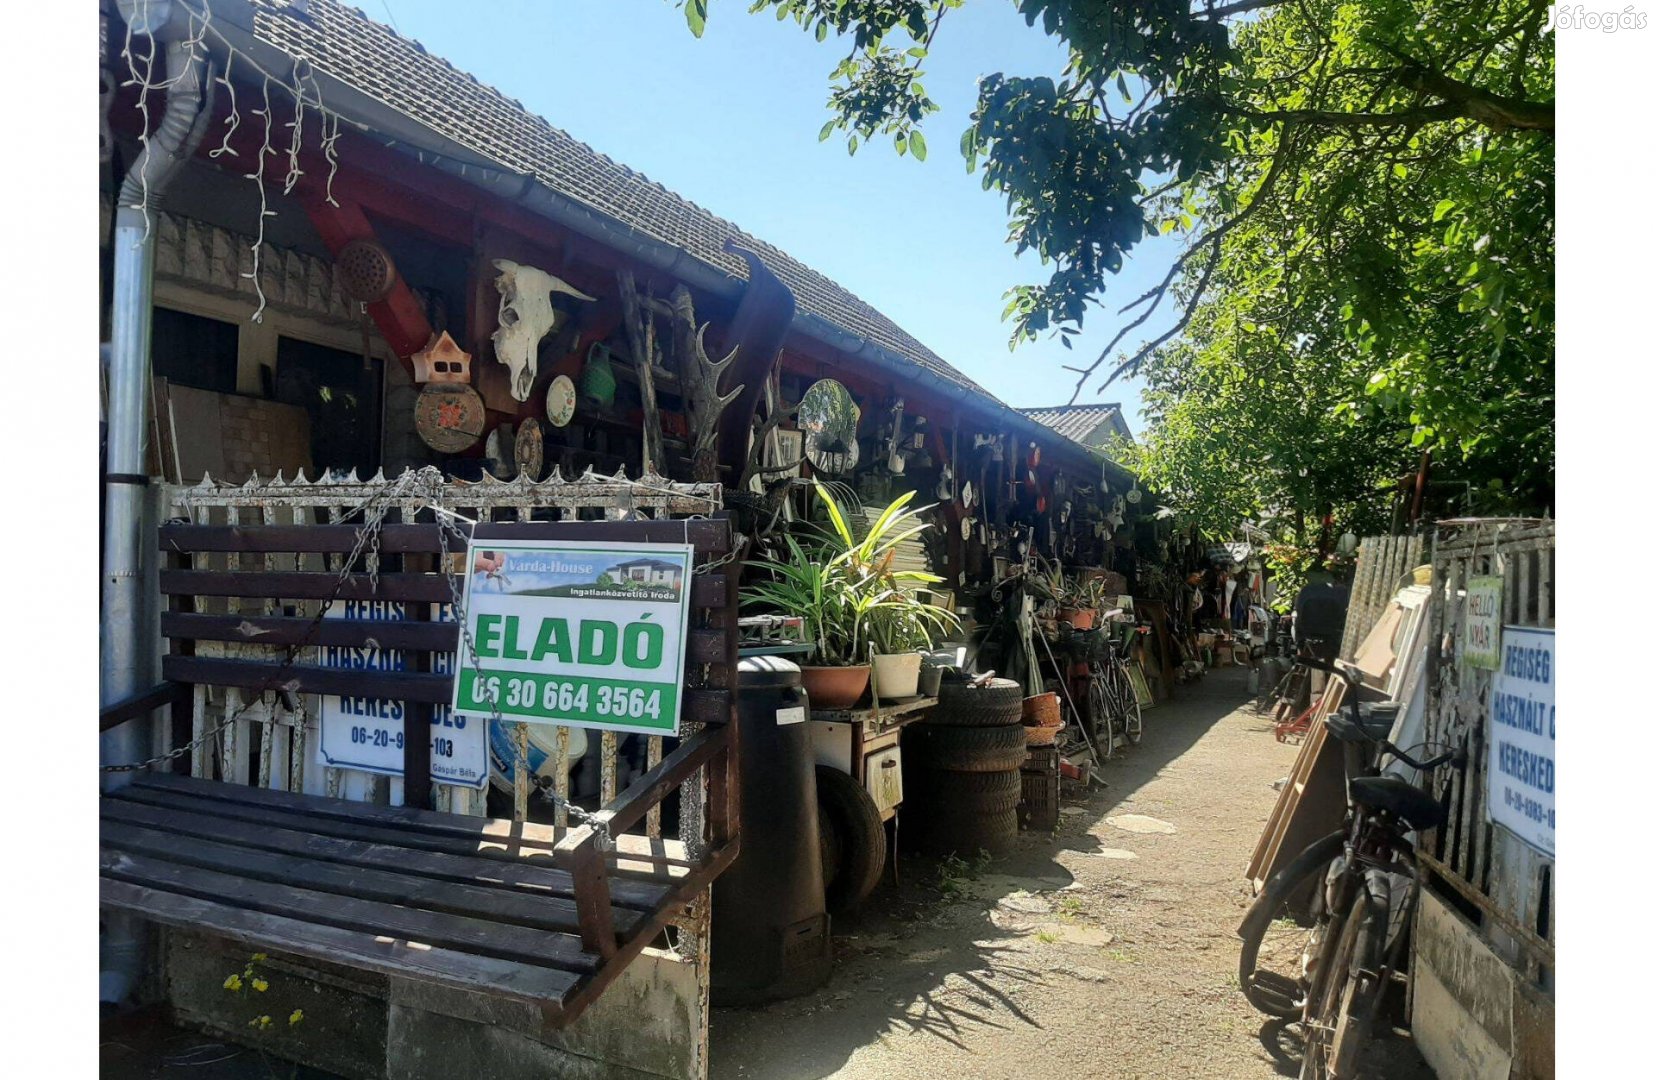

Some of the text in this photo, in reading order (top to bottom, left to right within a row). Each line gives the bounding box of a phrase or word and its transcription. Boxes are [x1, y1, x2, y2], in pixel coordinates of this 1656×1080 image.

[509, 559, 593, 574] Varda-House
[650, 592, 675, 600] Iroda
[474, 612, 664, 670] ELADÓ
[1504, 639, 1550, 684] RÉGISÉG
[471, 675, 661, 719] 06 30 664 3564
[1493, 691, 1546, 737] HASZNÁLT
[351, 726, 453, 758] 06-20-9-103
[1498, 740, 1554, 793] KERESKED
